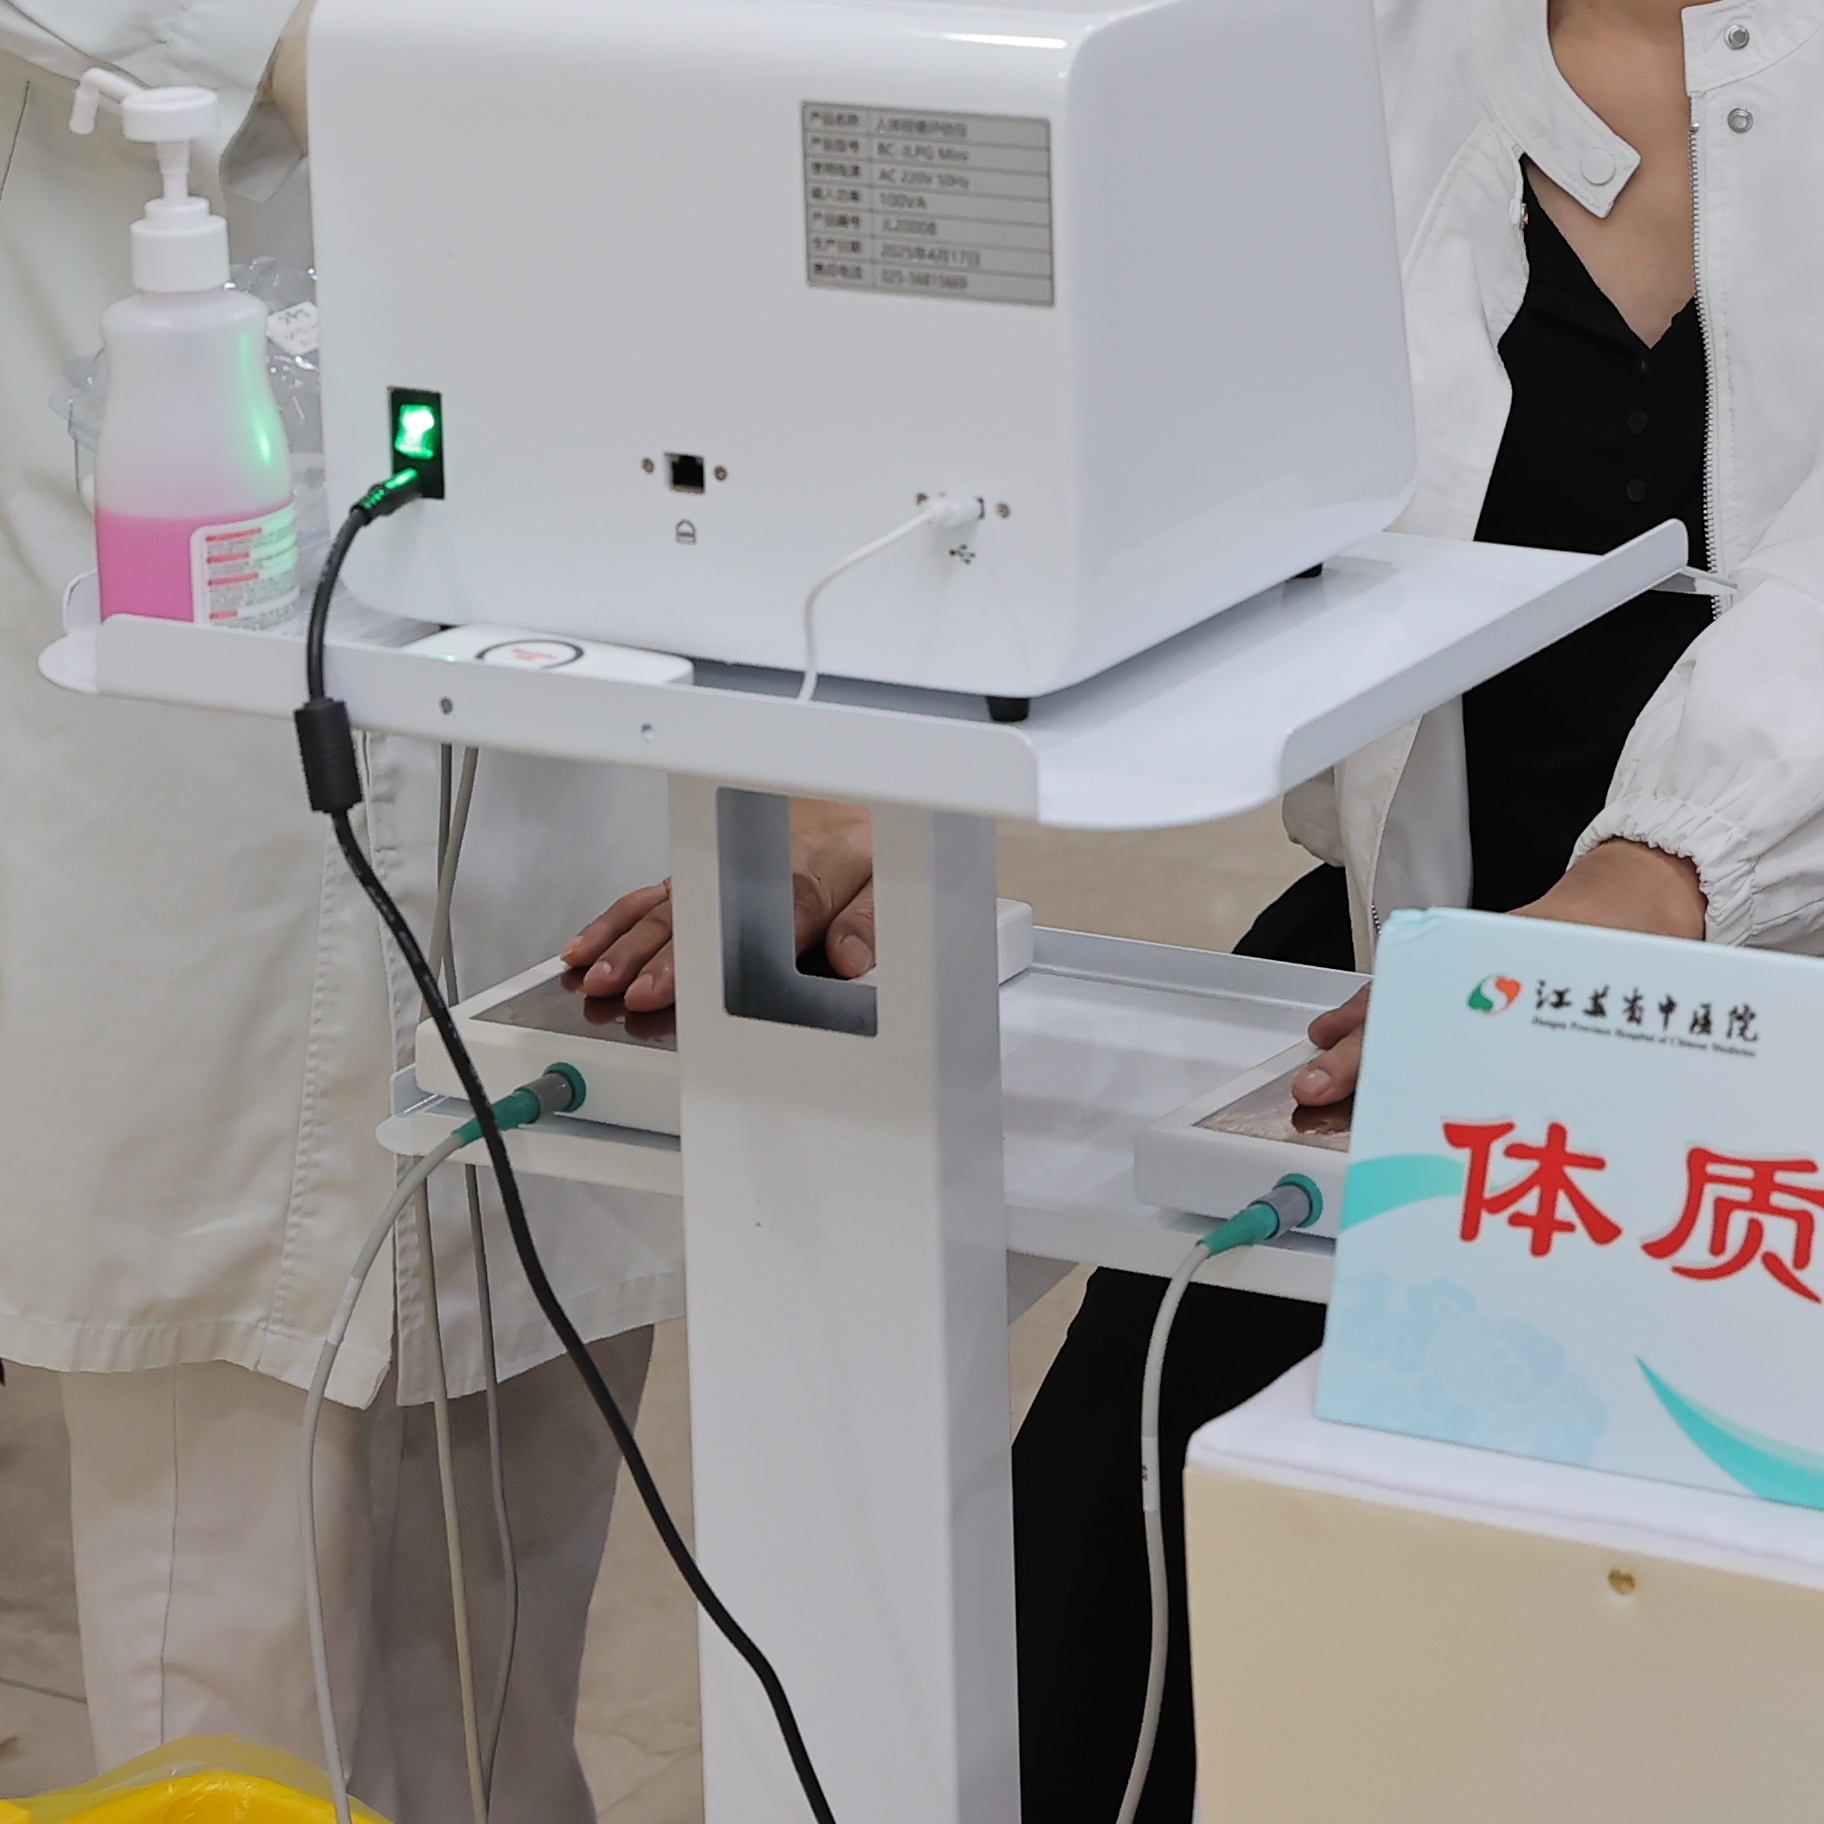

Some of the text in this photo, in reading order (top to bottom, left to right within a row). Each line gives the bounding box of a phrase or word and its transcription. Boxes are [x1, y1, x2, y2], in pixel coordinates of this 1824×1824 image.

[1534, 978, 1759, 1043] 江苏省中医院
